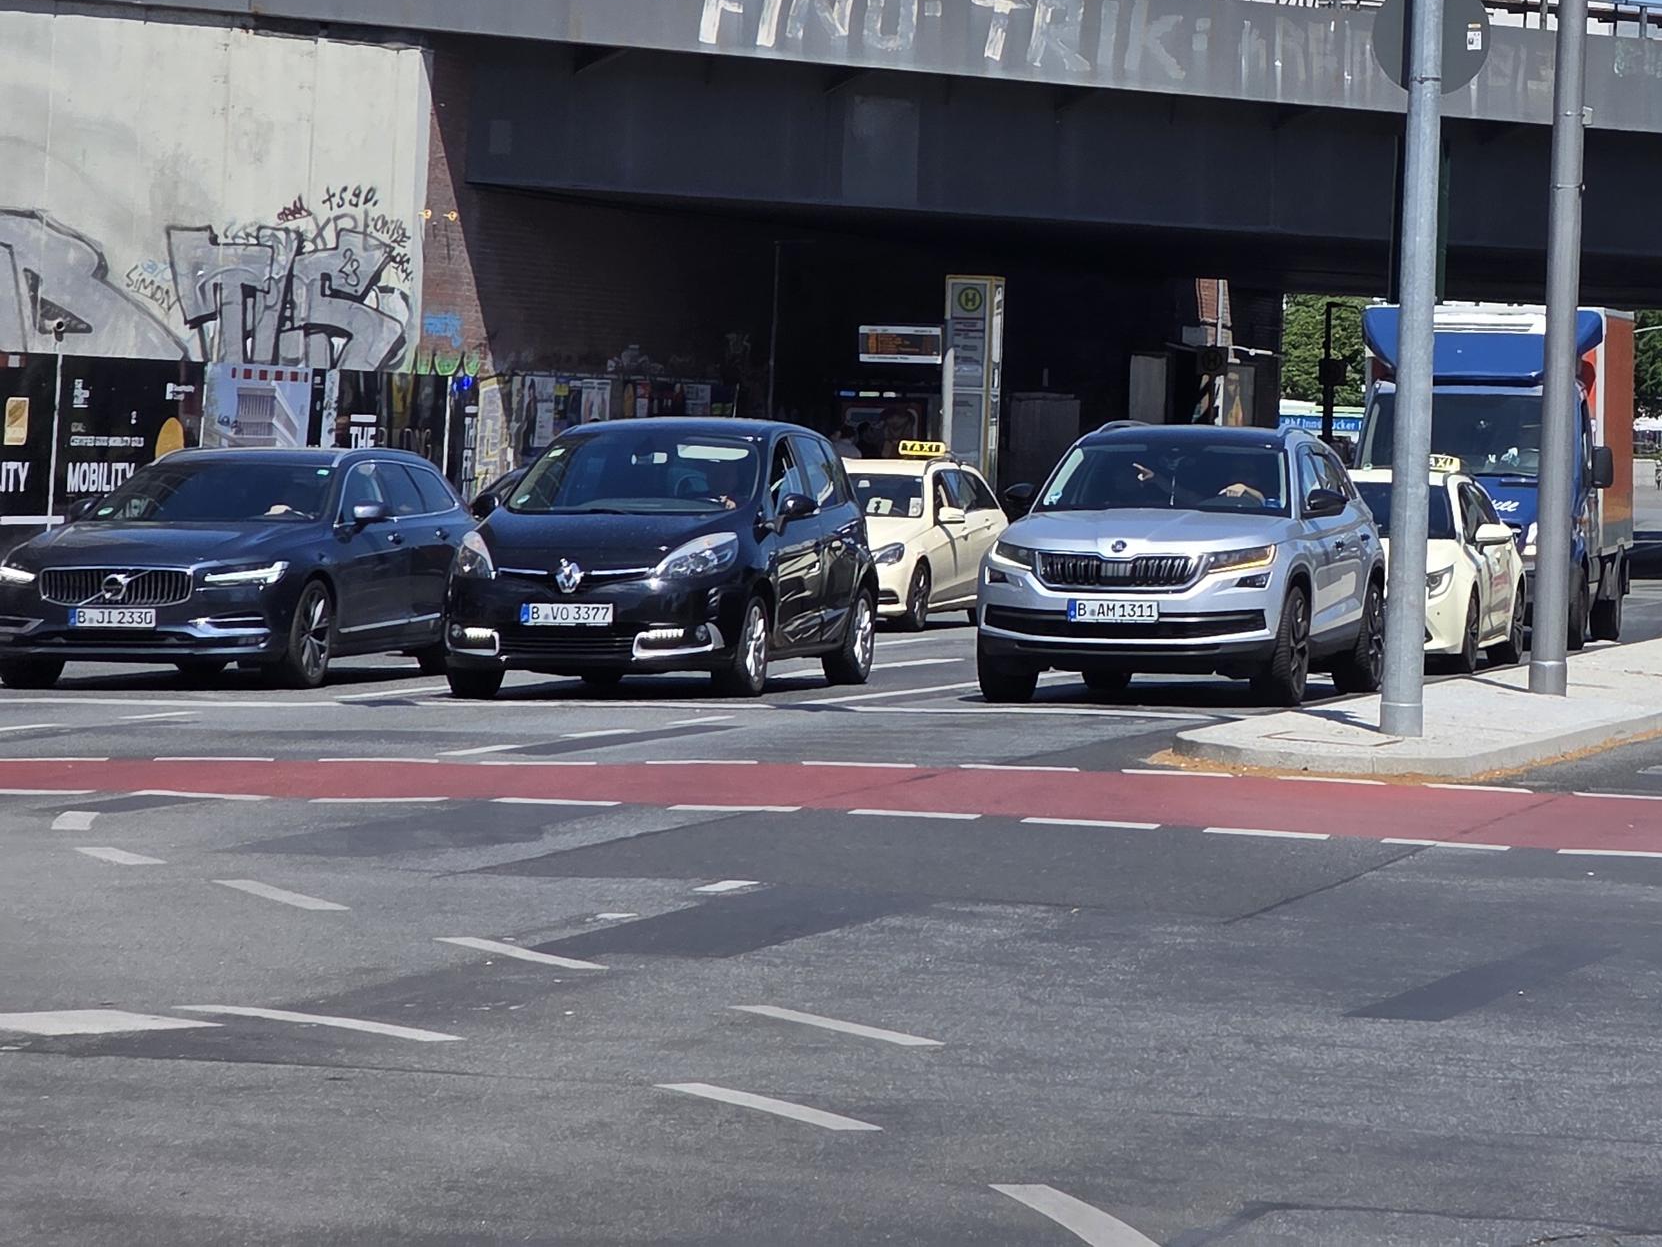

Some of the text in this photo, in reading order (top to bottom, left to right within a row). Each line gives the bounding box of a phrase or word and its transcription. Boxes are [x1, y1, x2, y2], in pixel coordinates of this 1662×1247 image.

[1429, 456, 1454, 468] AXI
[77, 610, 86, 624] B
[531, 606, 540, 620] B
[573, 606, 610, 620] 3377
[1077, 602, 1155, 618] B AM 1311
